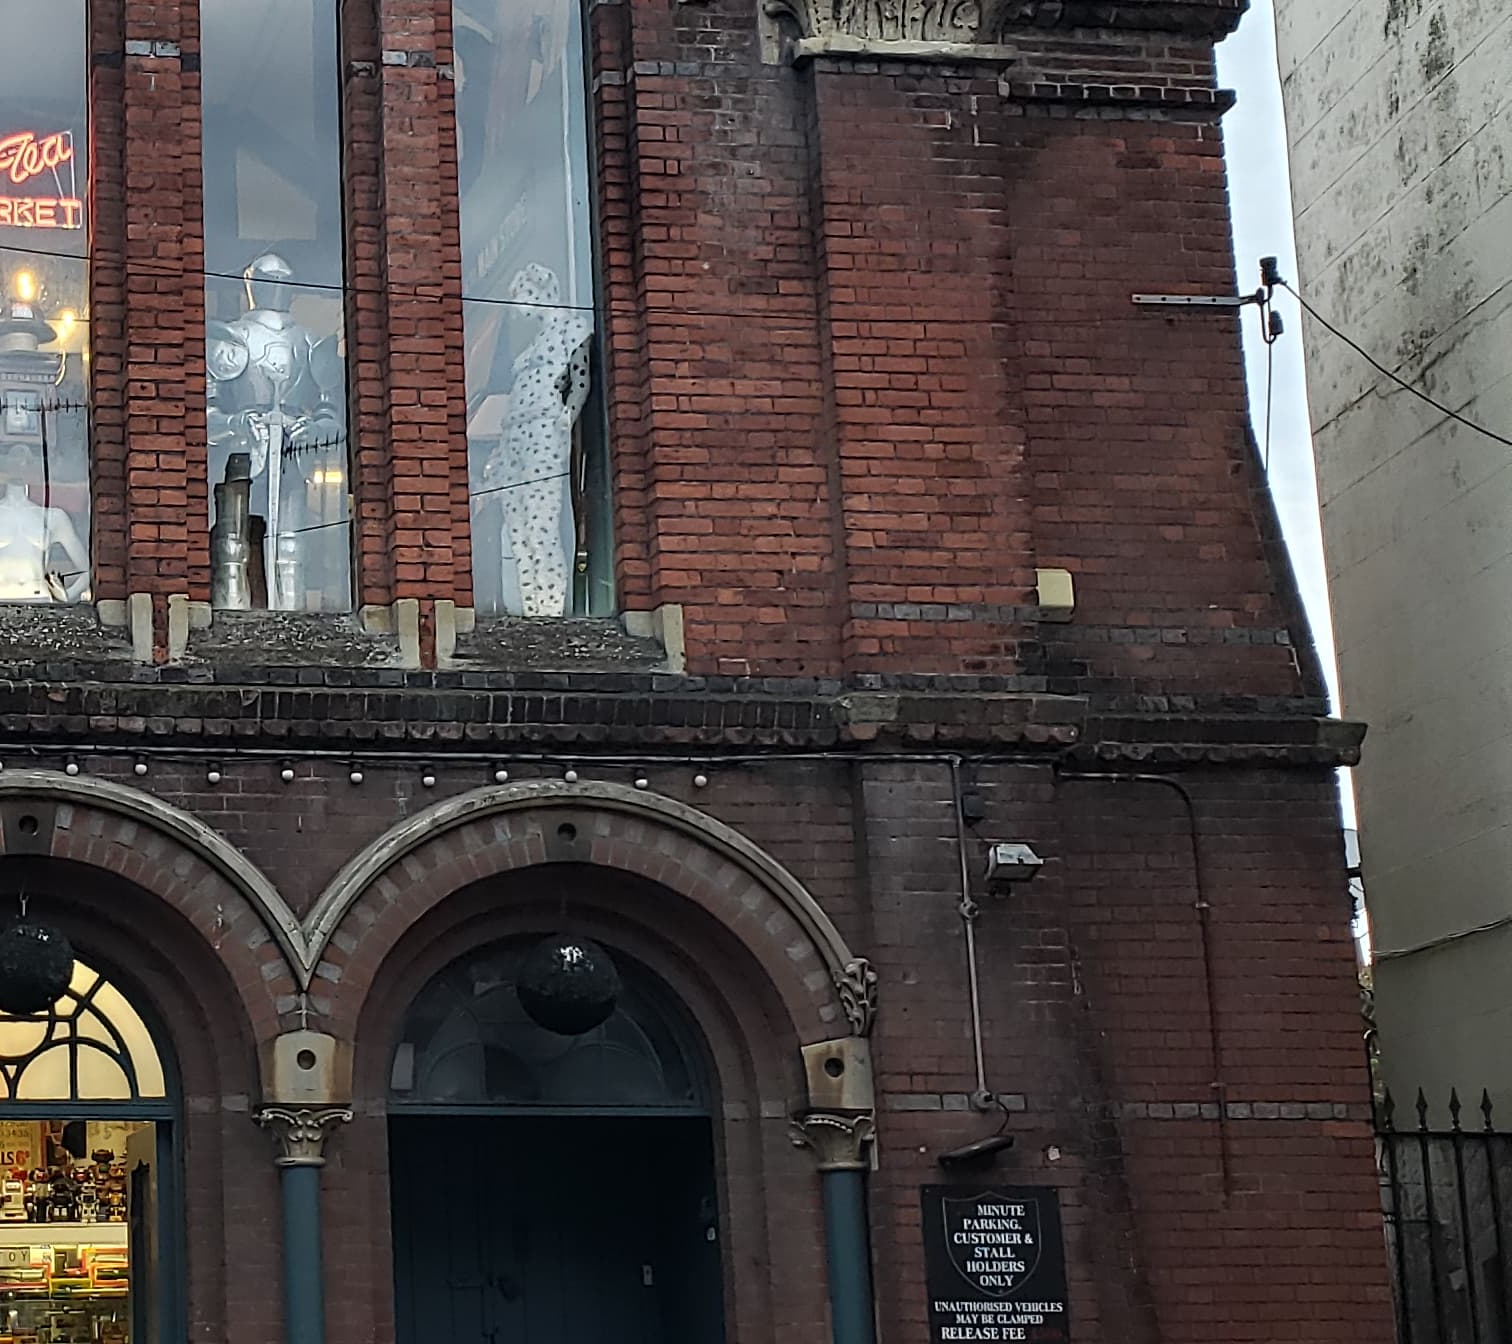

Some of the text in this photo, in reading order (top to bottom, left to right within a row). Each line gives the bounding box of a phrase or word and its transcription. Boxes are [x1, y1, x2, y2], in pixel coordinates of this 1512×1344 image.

[977, 1204, 1026, 1217] MINUTE
[963, 1218, 1023, 1231] PARKING.
[953, 1232, 1034, 1245] CUSTOMER &
[974, 1246, 1016, 1259] STALL
[966, 1260, 1026, 1273] HOLDERS
[979, 1274, 1014, 1287] ONLY
[934, 1301, 1064, 1313] UNAUTHORISED VEHICLES
[955, 1313, 1044, 1325] MAY BE CLAMPED
[941, 1326, 1000, 1340] RELEASE
[1002, 1327, 1026, 1340] FEE
